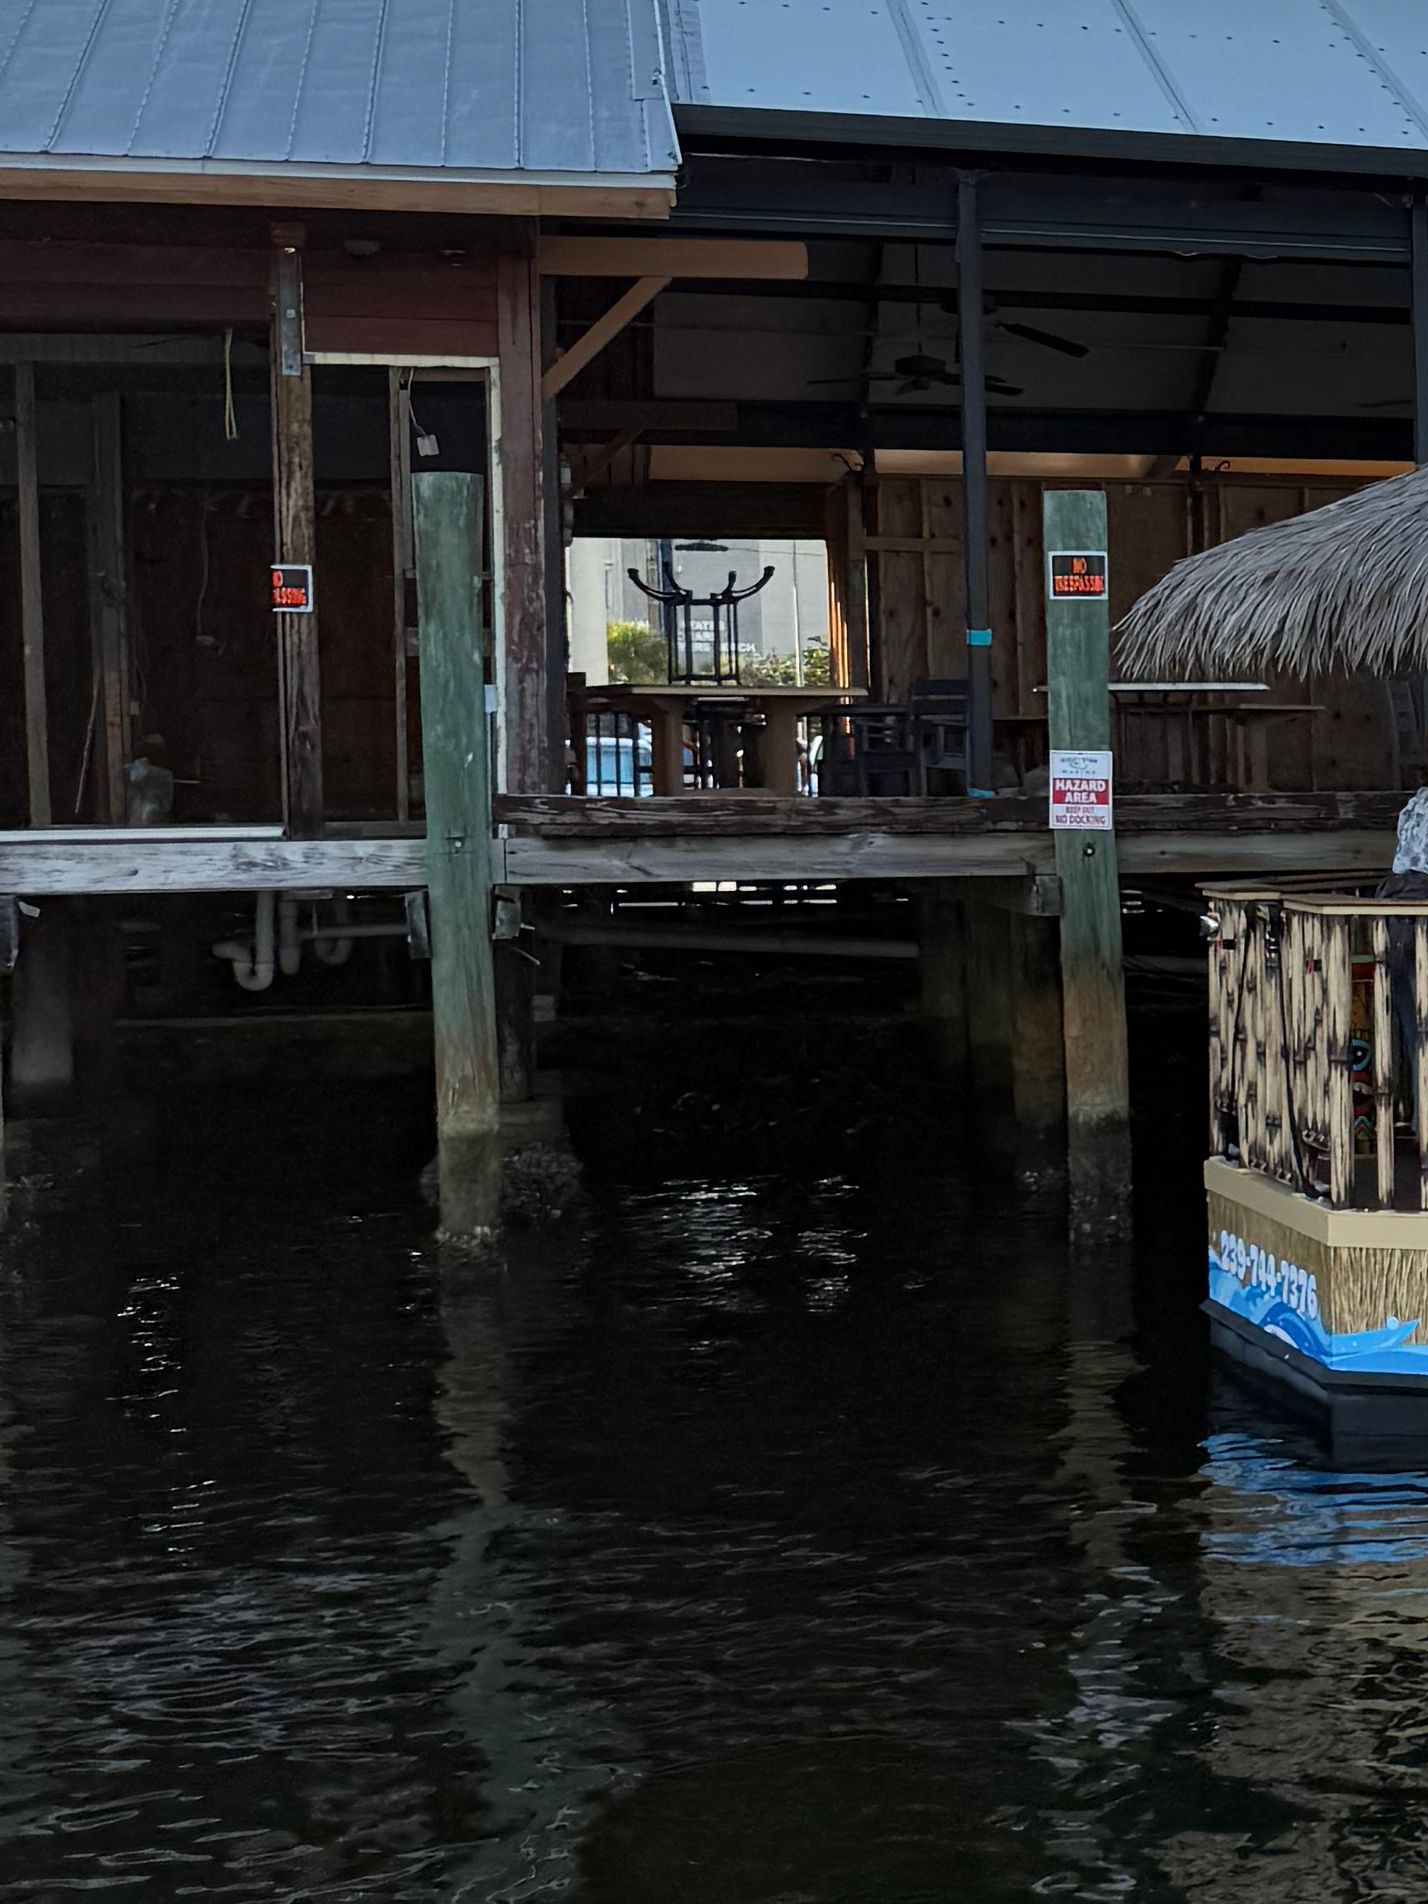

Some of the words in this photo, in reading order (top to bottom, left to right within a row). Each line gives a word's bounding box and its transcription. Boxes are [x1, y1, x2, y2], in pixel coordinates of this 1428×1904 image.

[1055, 779, 1107, 792] HAZARD
[1065, 791, 1097, 803] AREA
[1220, 1229, 1318, 1320] 239-744-7376
